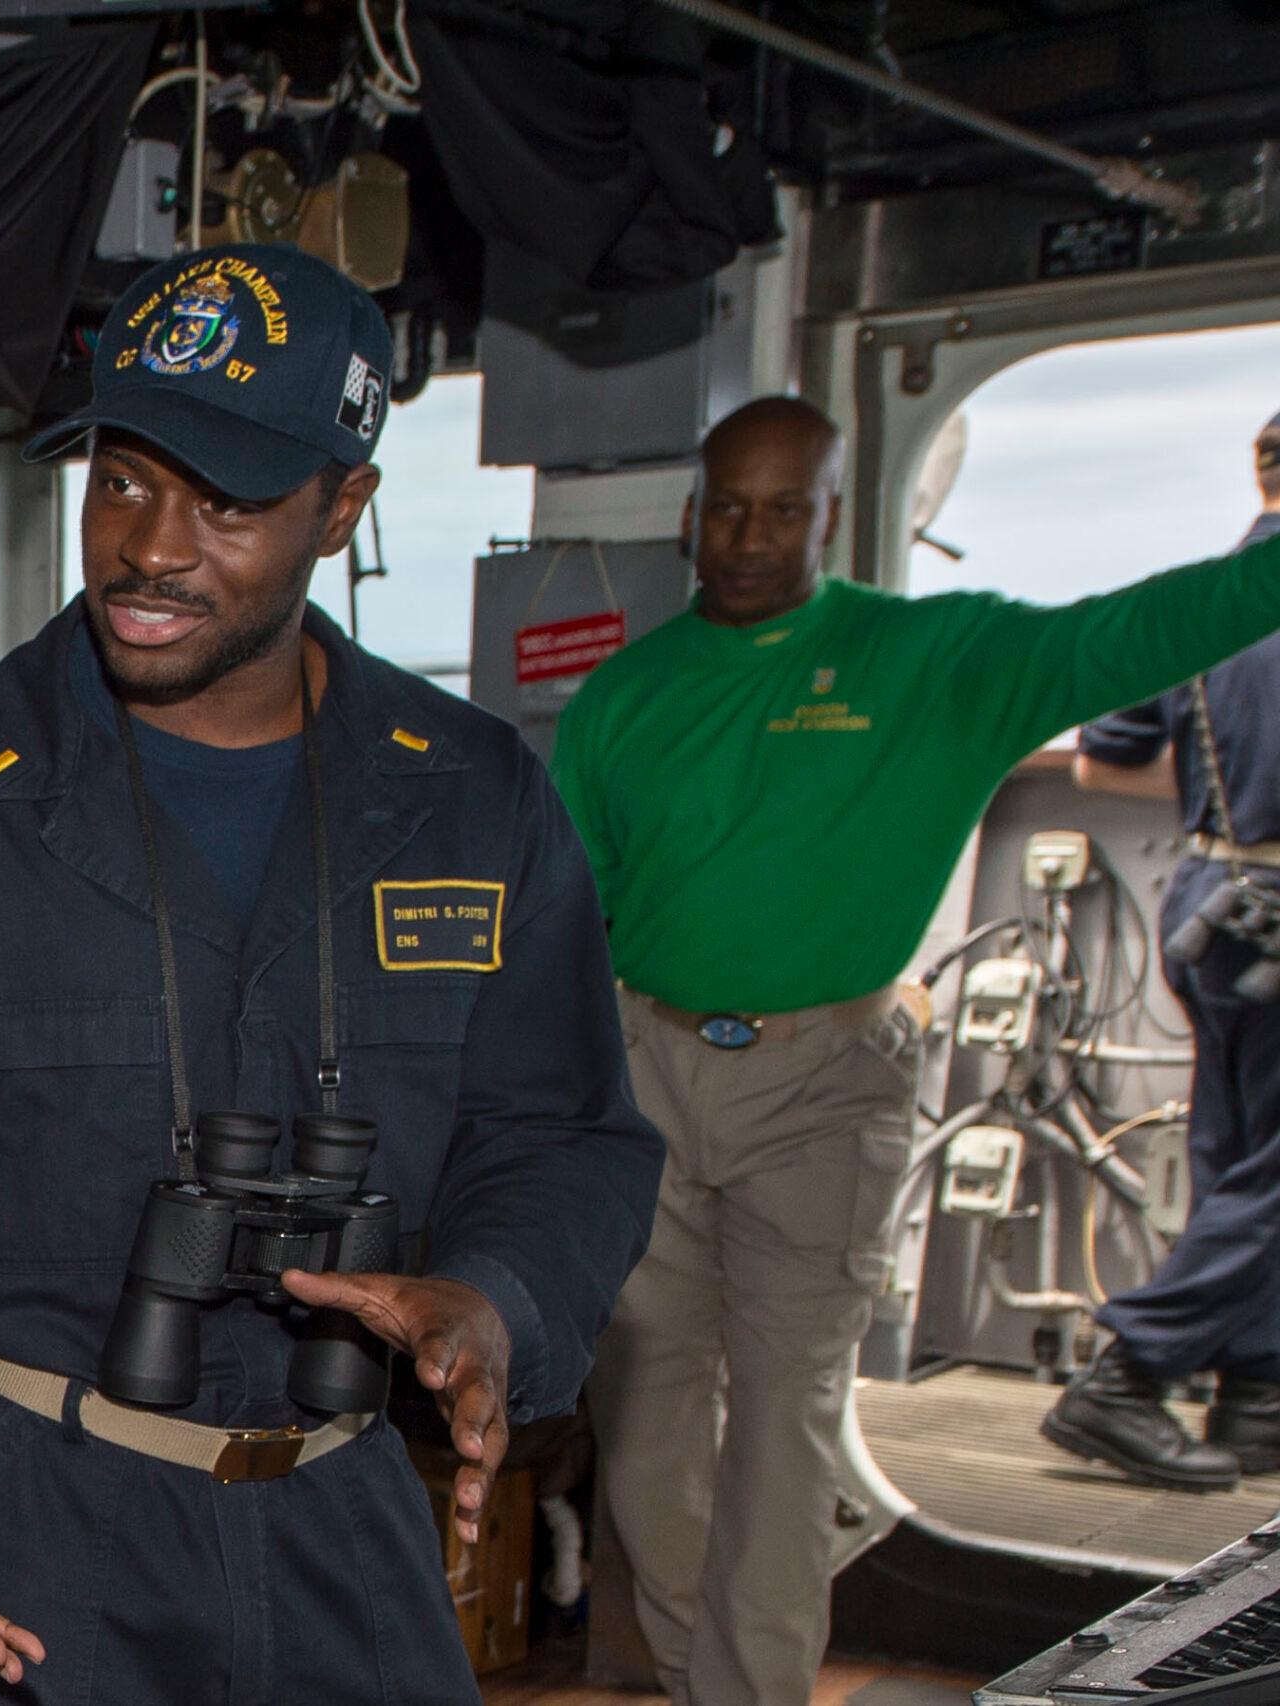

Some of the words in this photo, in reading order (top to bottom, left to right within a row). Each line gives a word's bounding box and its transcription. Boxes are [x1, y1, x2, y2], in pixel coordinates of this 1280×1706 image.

[214, 257, 289, 345] CHAMPLAIN
[225, 358, 257, 384] 67
[393, 906, 438, 921] DIMITRI
[396, 934, 420, 948] ENS
